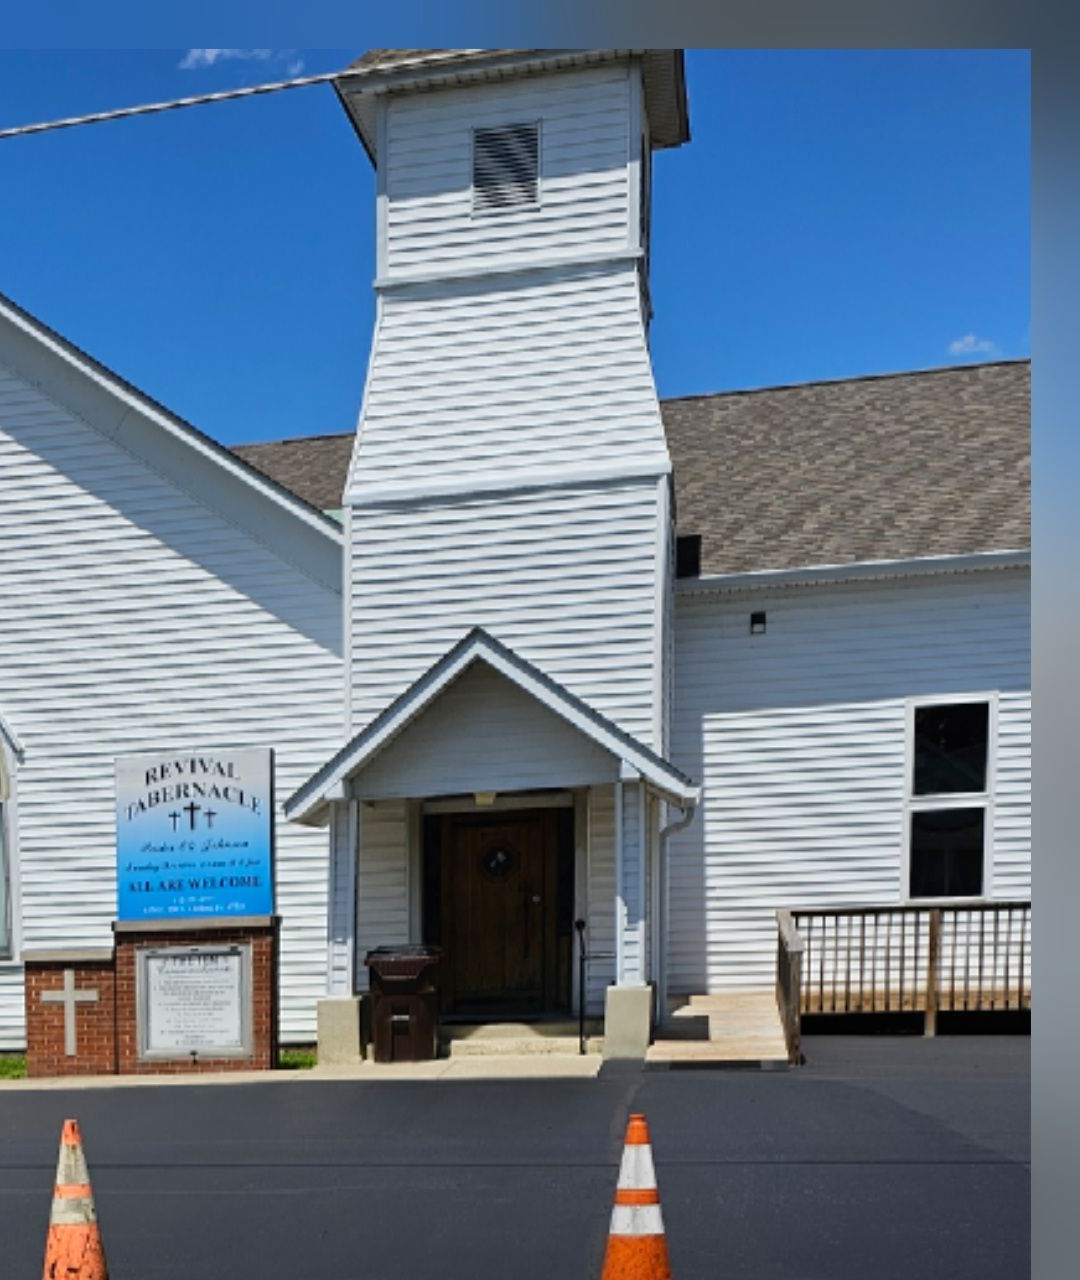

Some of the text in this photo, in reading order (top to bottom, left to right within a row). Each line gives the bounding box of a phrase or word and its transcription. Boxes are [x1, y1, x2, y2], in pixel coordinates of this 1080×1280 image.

[145, 757, 241, 786] REVIVAL
[125, 782, 261, 822] TABERNACLE
[128, 876, 263, 893] ALL ARE WELCOME
